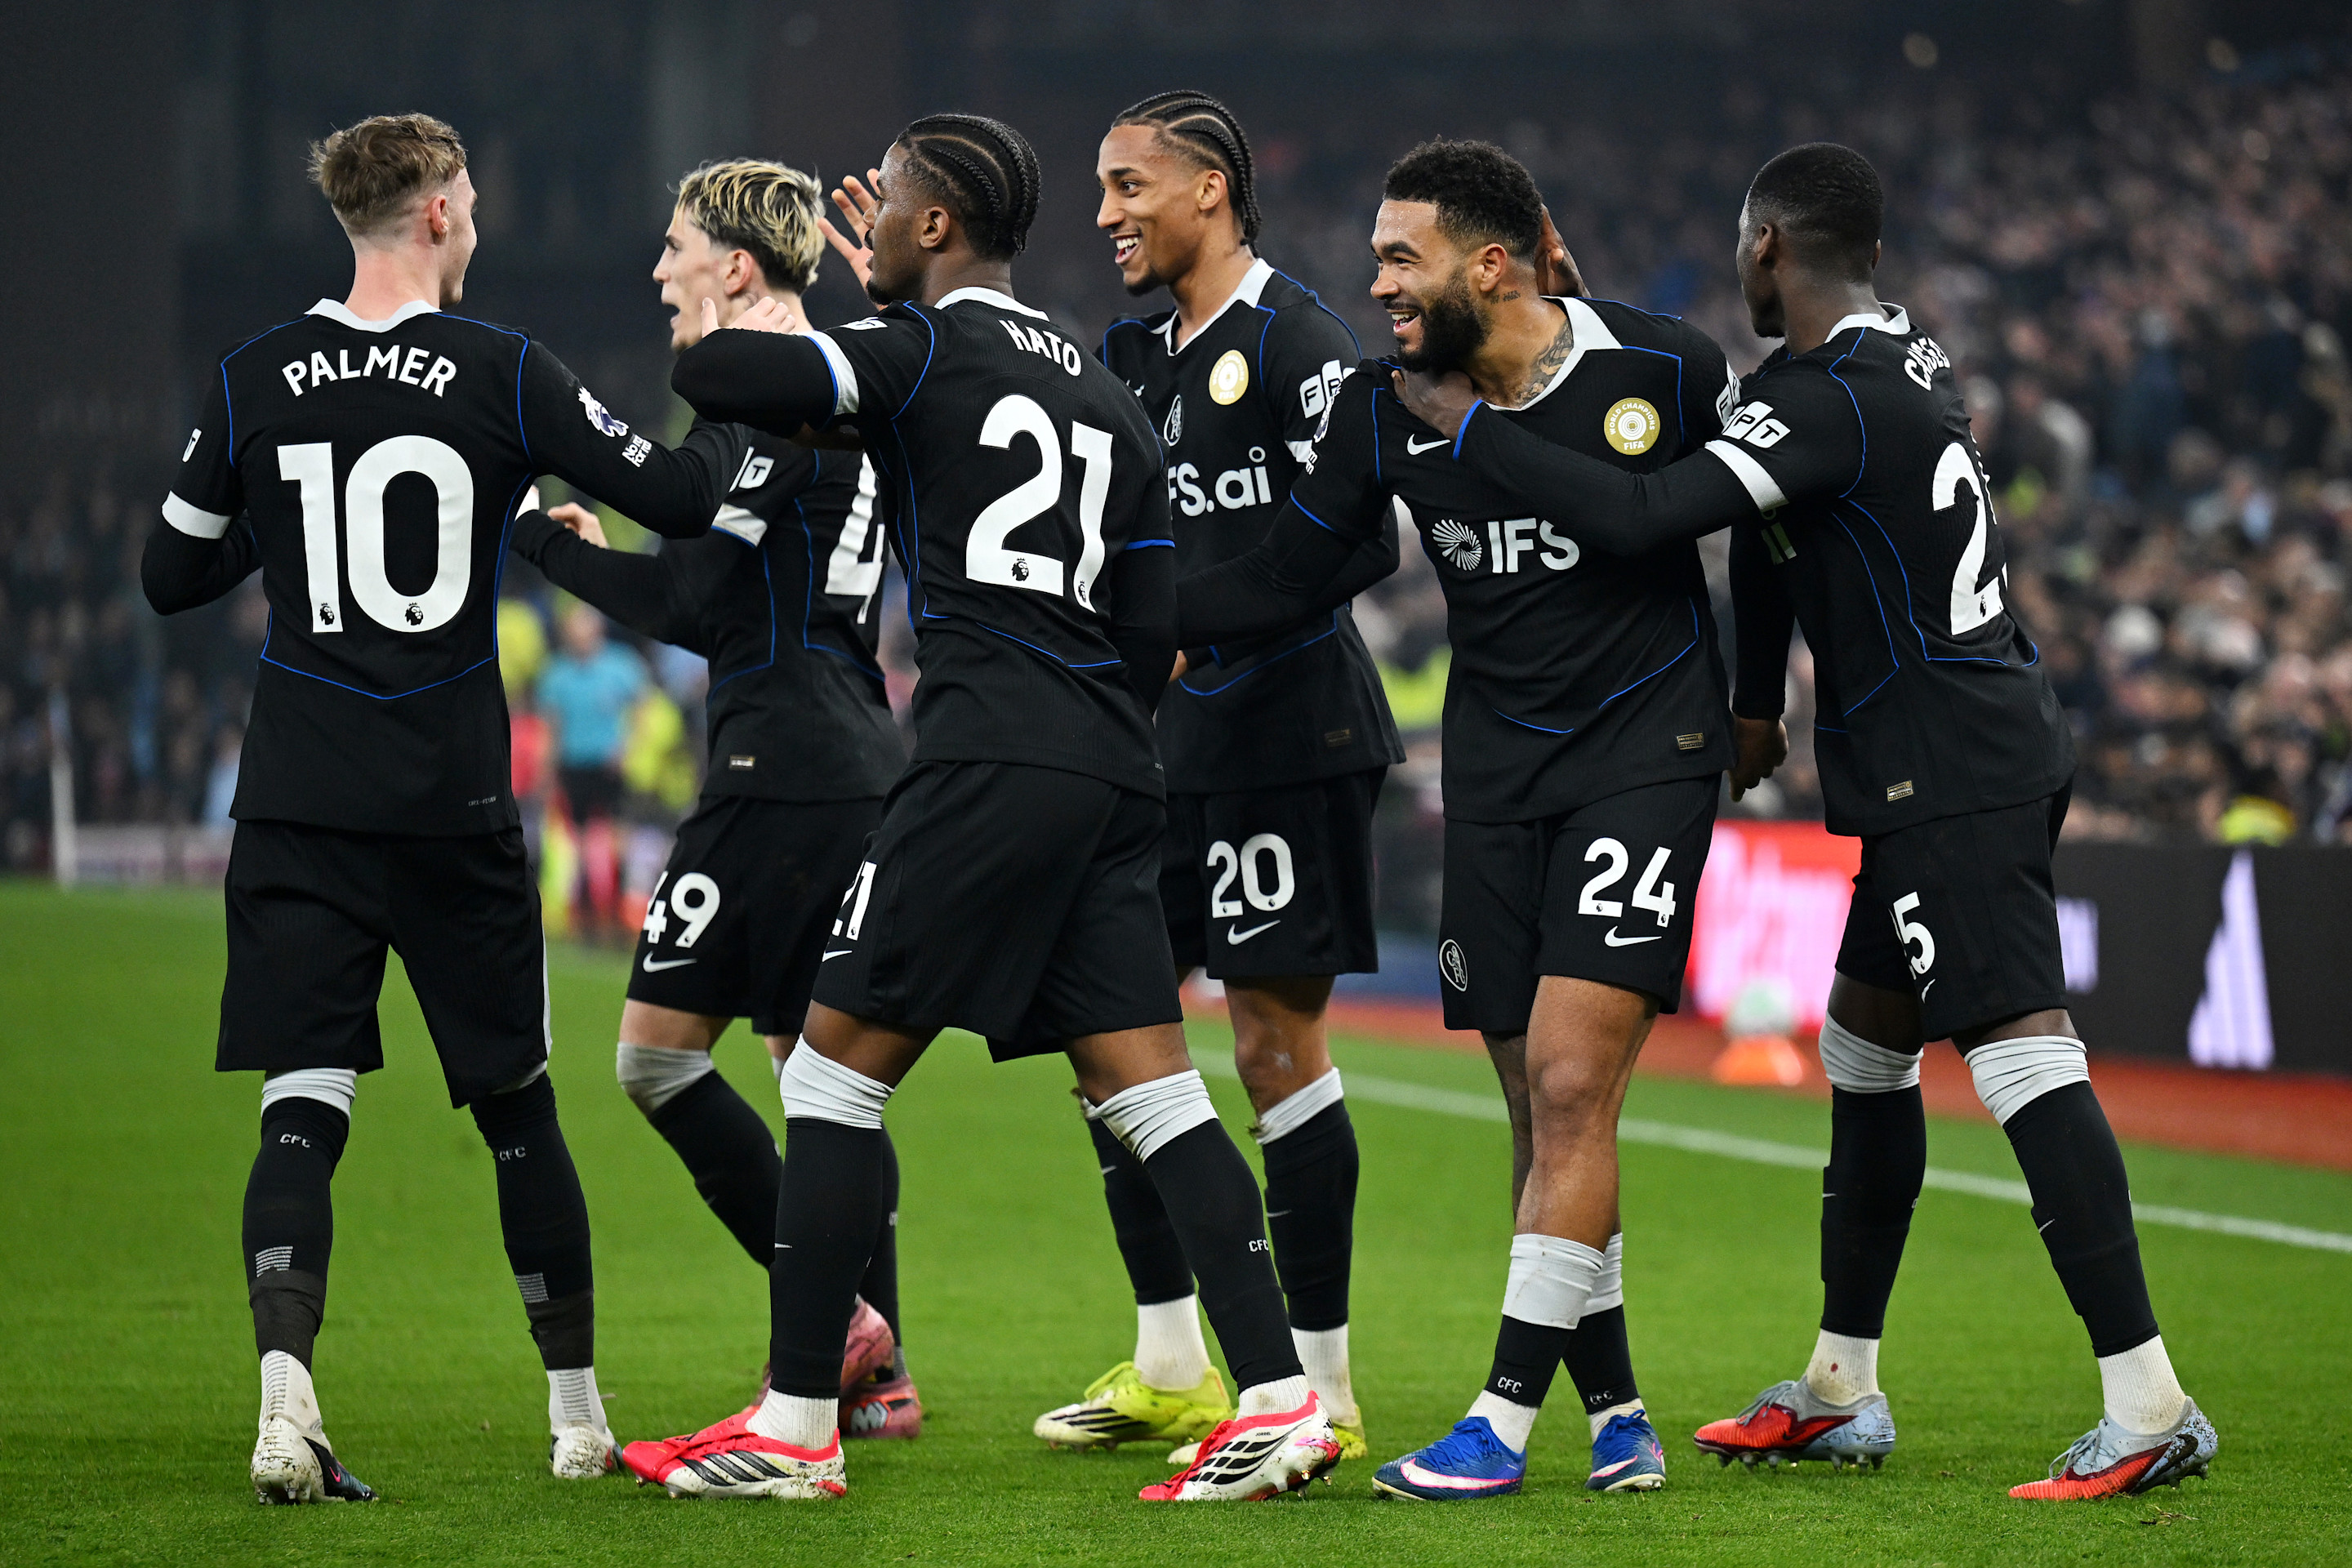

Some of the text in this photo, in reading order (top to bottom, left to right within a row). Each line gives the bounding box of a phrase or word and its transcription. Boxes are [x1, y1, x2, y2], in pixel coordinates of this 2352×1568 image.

[282, 345, 457, 398] PALMER
[999, 320, 1082, 376] HATO
[1609, 403, 1655, 435] WORLD CHAMPIONS
[1624, 441, 1645, 450] FIFA
[966, 394, 1113, 613] 21
[278, 435, 474, 633] 10
[1488, 518, 1580, 573] IFS
[1932, 442, 2008, 635] 2
[1206, 833, 1295, 919] 20
[1578, 837, 1677, 928] 24
[643, 871, 721, 948] 49
[1888, 891, 1936, 981] 5
[279, 1133, 310, 1148] CFC
[499, 1146, 527, 1161] CFC
[1248, 1239, 1269, 1252] CFC
[1497, 1376, 1522, 1394] CFC
[1589, 1390, 1614, 1405] CFC
